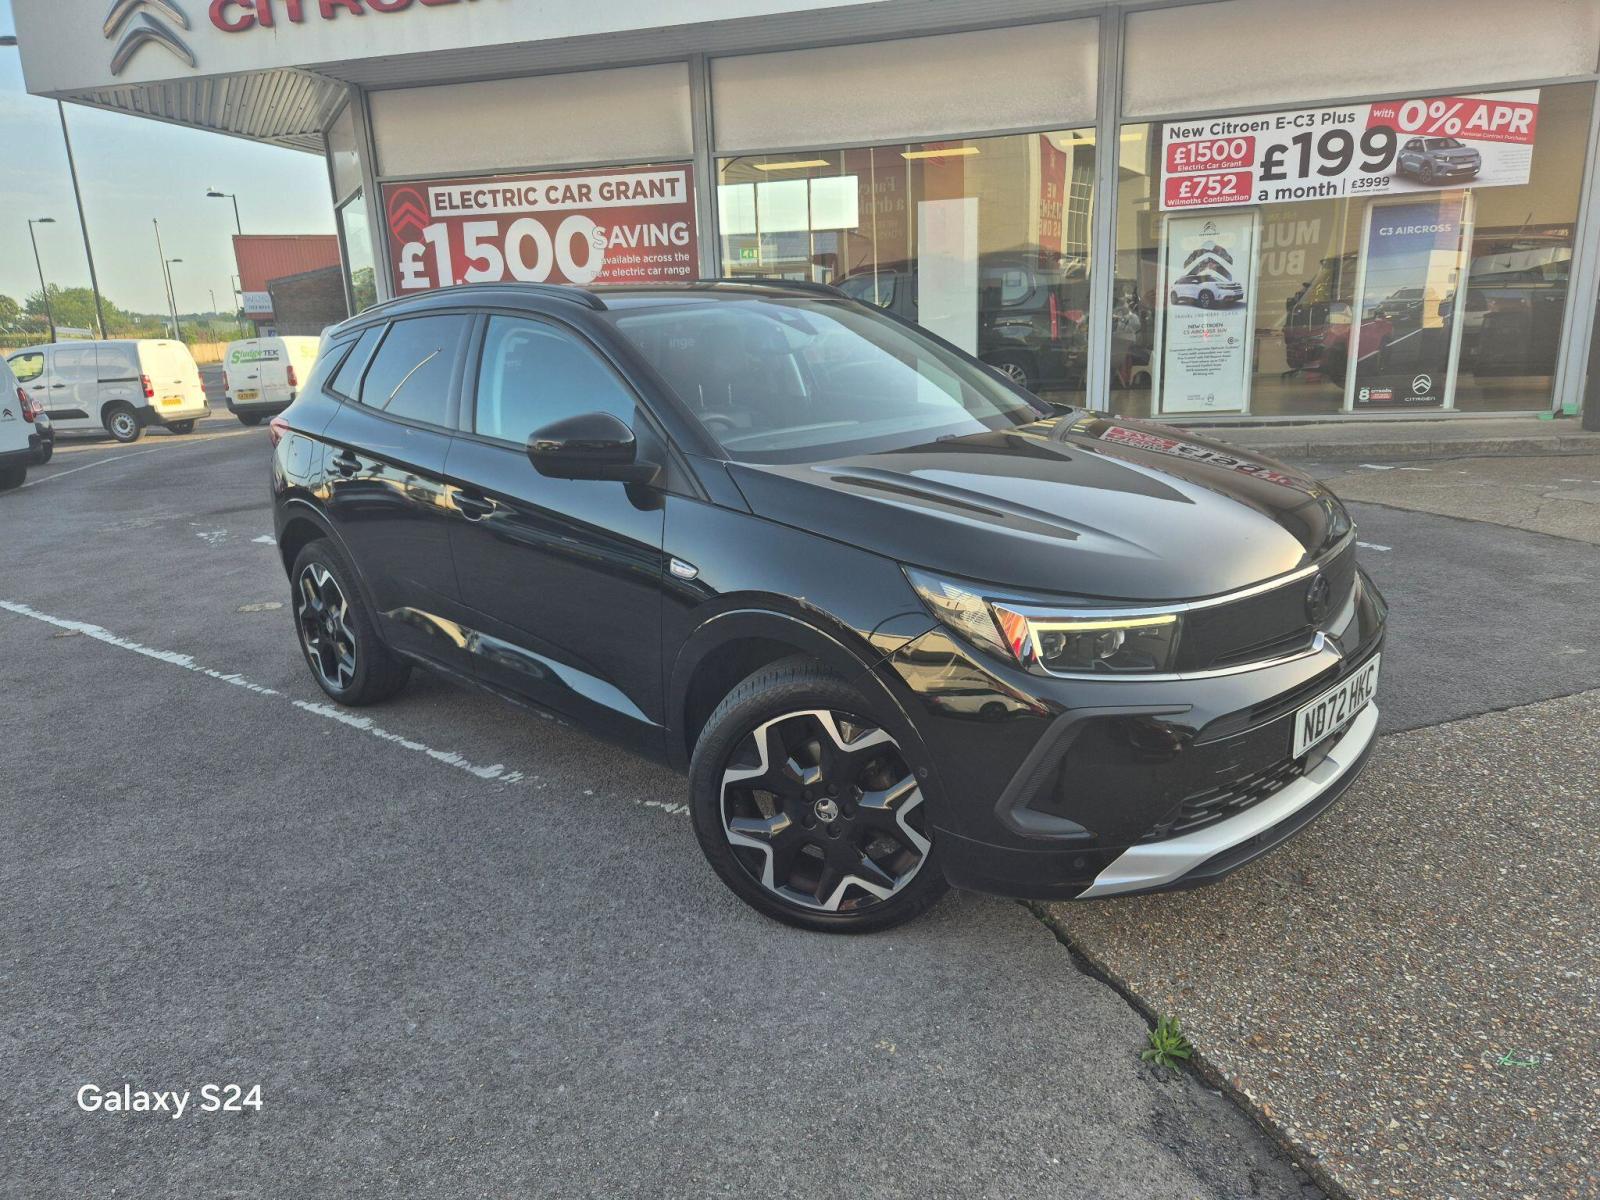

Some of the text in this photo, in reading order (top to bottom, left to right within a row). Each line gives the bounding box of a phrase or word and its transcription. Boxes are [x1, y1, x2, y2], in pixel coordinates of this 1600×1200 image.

[1169, 112, 1356, 139] New Citroen E-C3 Plus
[1373, 99, 1534, 135] with 0% APR
[1174, 138, 1247, 164] £1500
[1259, 125, 1398, 181] £199
[1178, 163, 1205, 172] Electric
[1221, 160, 1242, 168] Grant
[1179, 174, 1237, 198] £752
[1258, 181, 1337, 201] a month
[1351, 176, 1390, 189] £3999
[434, 177, 680, 211] ELECTRIC CAR GRANT
[1167, 194, 1249, 206] Wilmoths Contribution
[1380, 223, 1452, 236] C3 AIRCROSS
[600, 251, 690, 265] available across the
[612, 266, 646, 277] electric
[647, 268, 662, 276] car
[664, 265, 690, 275] range
[1303, 663, 1375, 748] ND72 HKC
